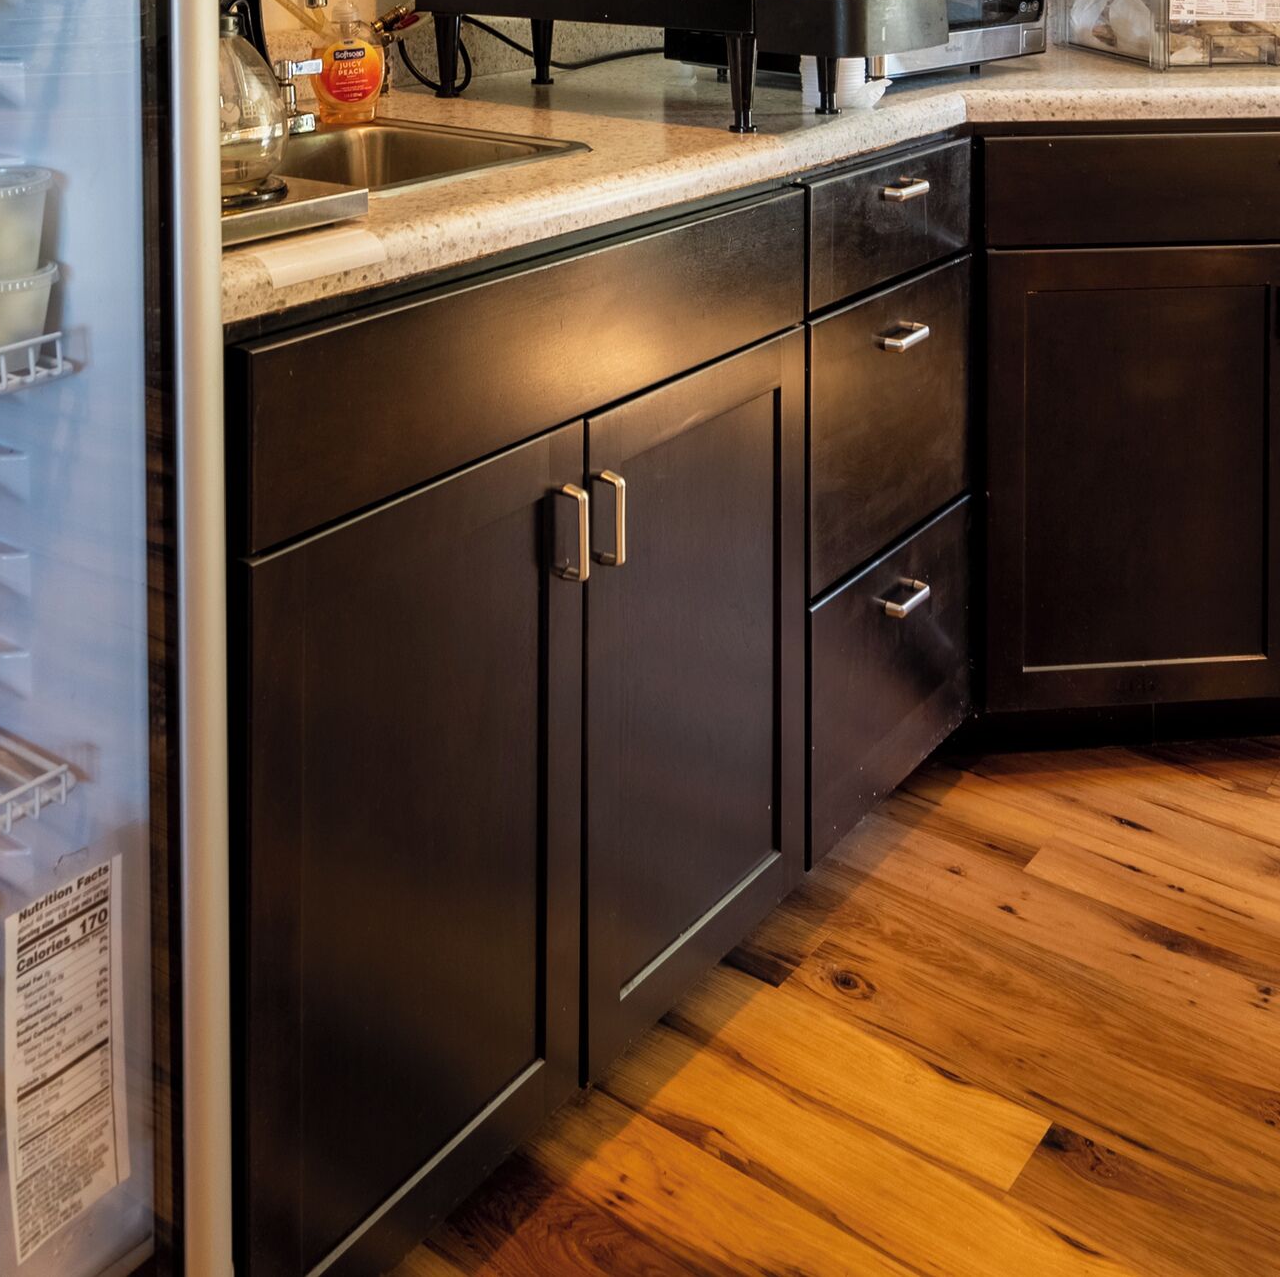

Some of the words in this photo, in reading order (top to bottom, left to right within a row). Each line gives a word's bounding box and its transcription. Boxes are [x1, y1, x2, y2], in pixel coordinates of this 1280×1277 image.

[335, 49, 364, 60] Softsoap
[340, 60, 362, 70] JUICY
[338, 67, 364, 76] PEACH
[18, 885, 73, 923] Nutrition
[77, 865, 109, 889] Facts
[16, 935, 71, 973] Calories
[80, 907, 108, 935] 170
